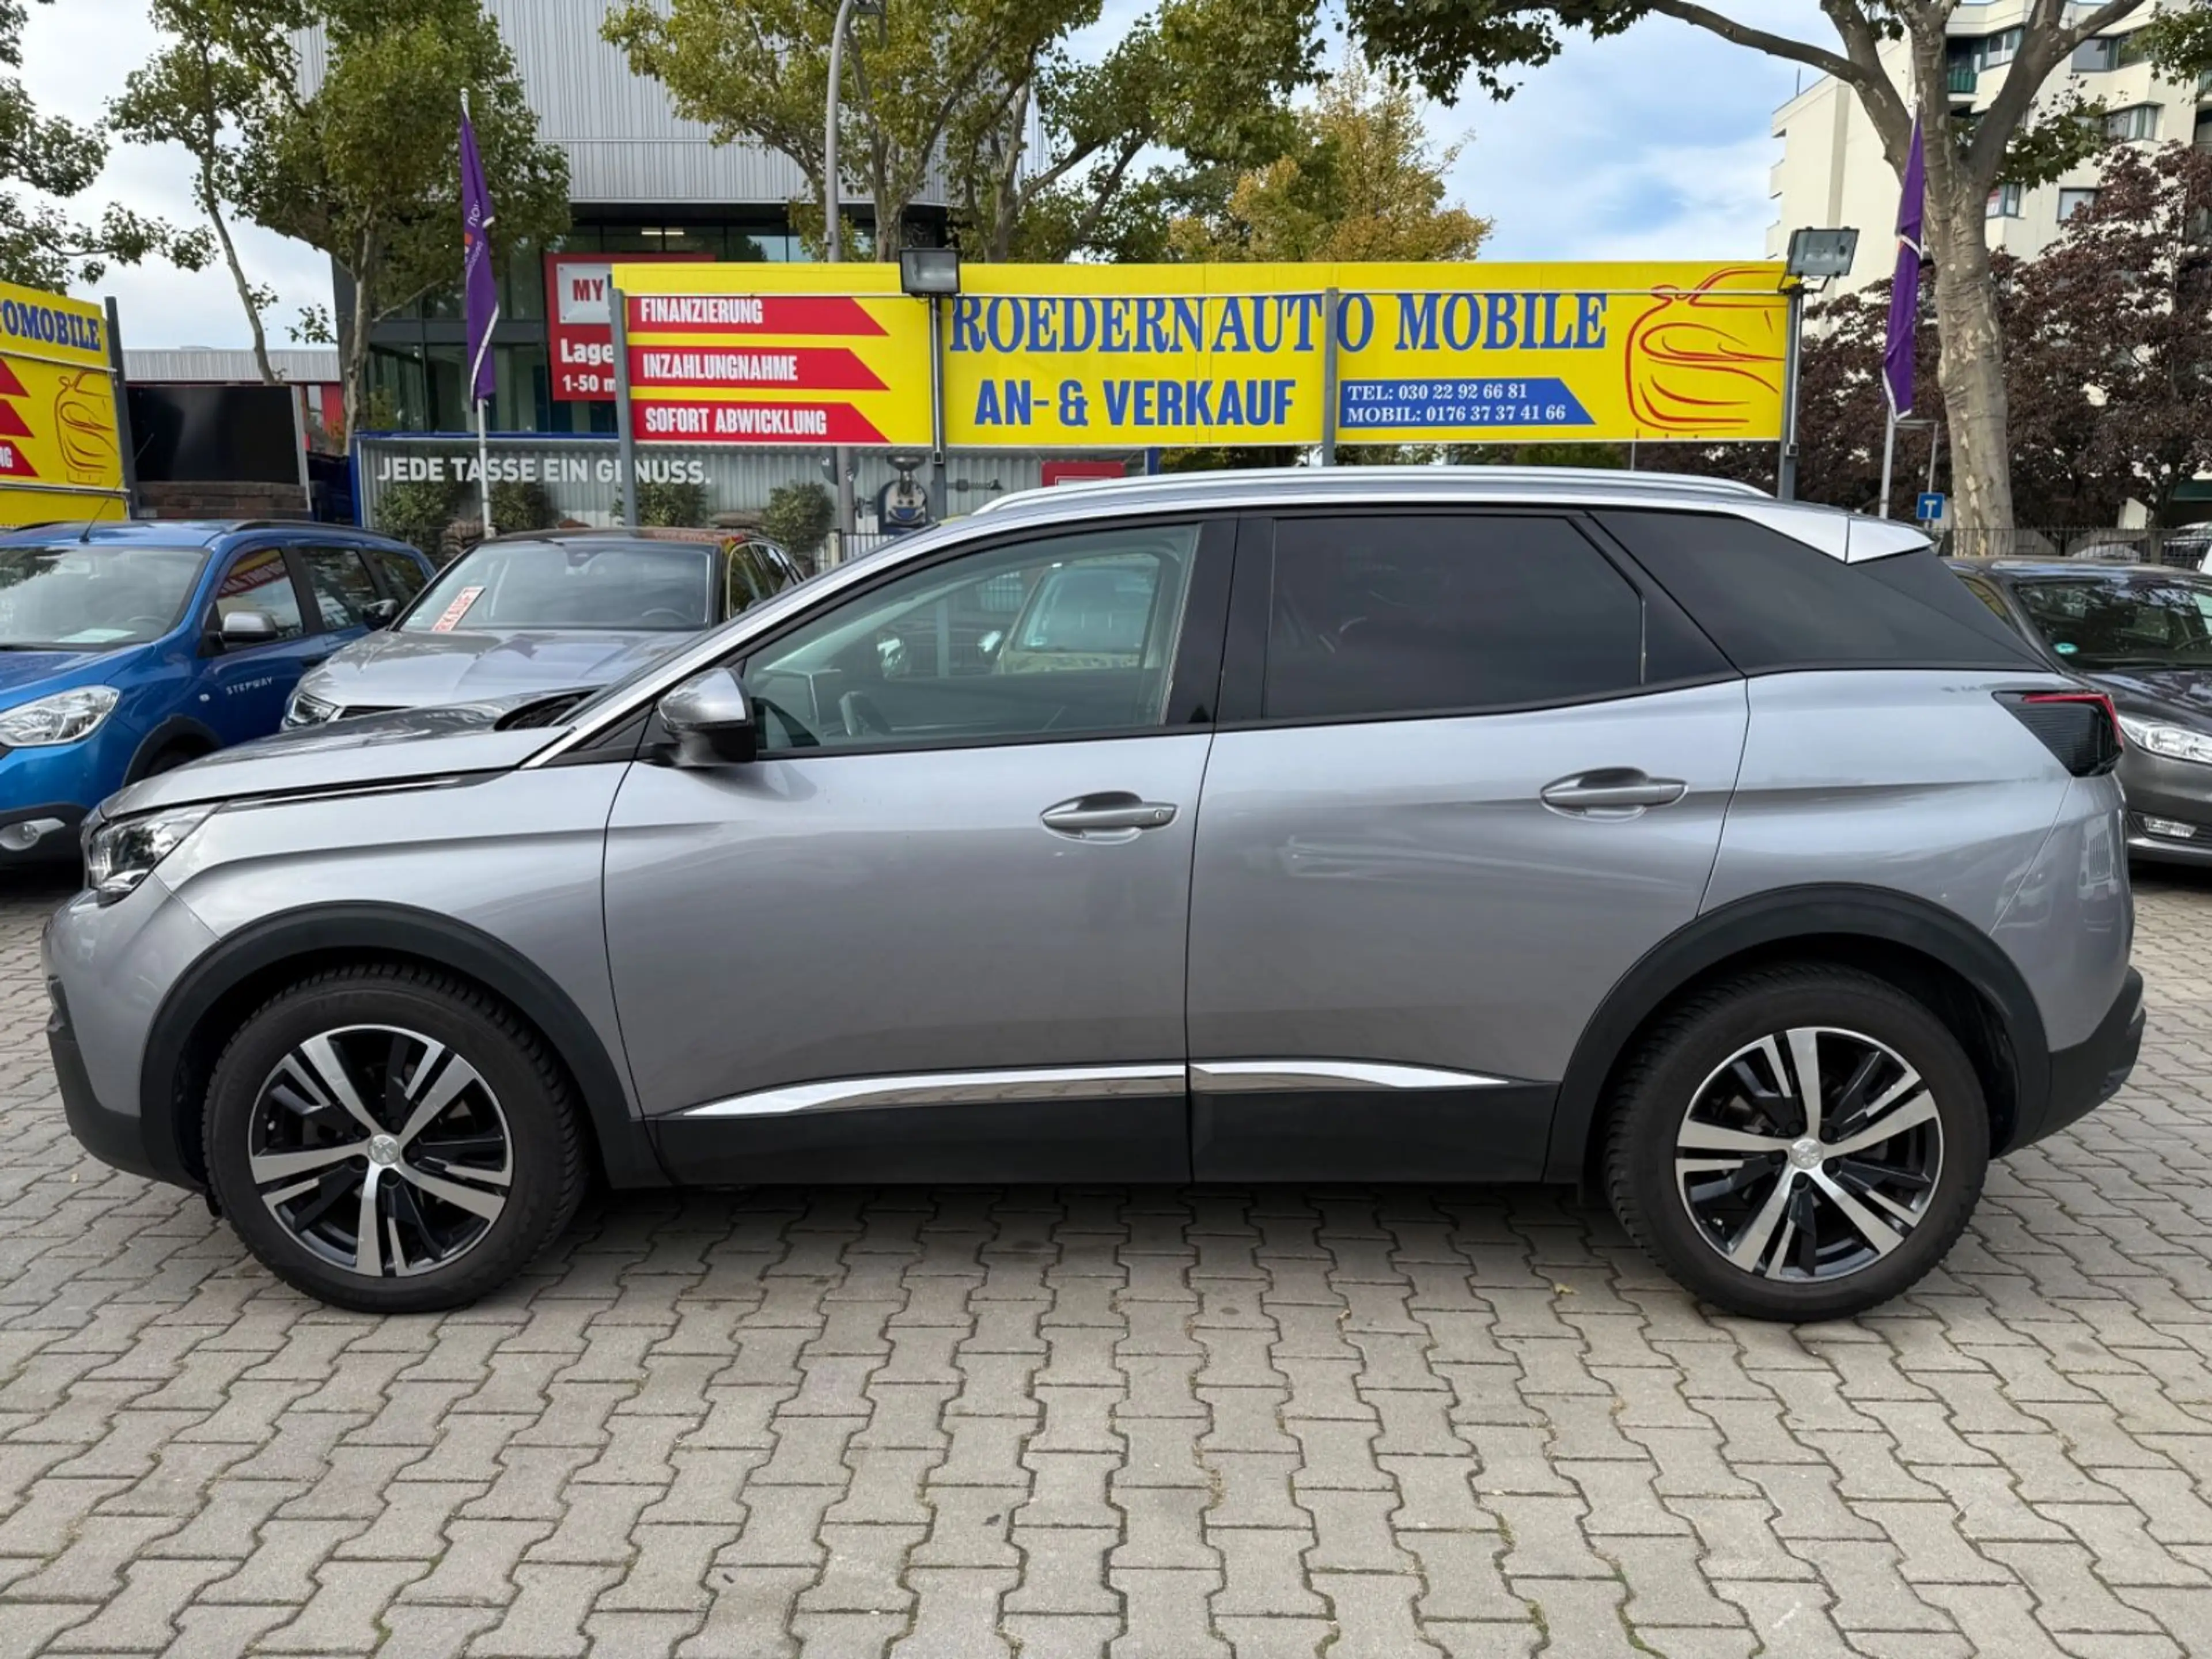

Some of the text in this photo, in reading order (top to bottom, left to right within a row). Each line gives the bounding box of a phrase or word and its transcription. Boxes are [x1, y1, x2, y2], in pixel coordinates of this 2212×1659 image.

[573, 279, 604, 301] MY
[641, 298, 763, 324] FINANZIERUNG
[0, 299, 101, 352] OMOBILE
[643, 354, 798, 381] INZAHLUNGNAHME
[562, 374, 599, 392] 1-50
[1348, 384, 1527, 400] TEL: 030 22 92 66 81
[975, 379, 1296, 426] AN- & VERKAUF
[1347, 404, 1566, 423] MOBIL: 0176 37 37 41 66
[646, 408, 827, 434] SOFORT ABWICKLUNG
[377, 457, 445, 482] JEDE
[450, 458, 537, 482] TASSE
[543, 459, 587, 483] EIN
[226, 676, 272, 695] STEPWAY
